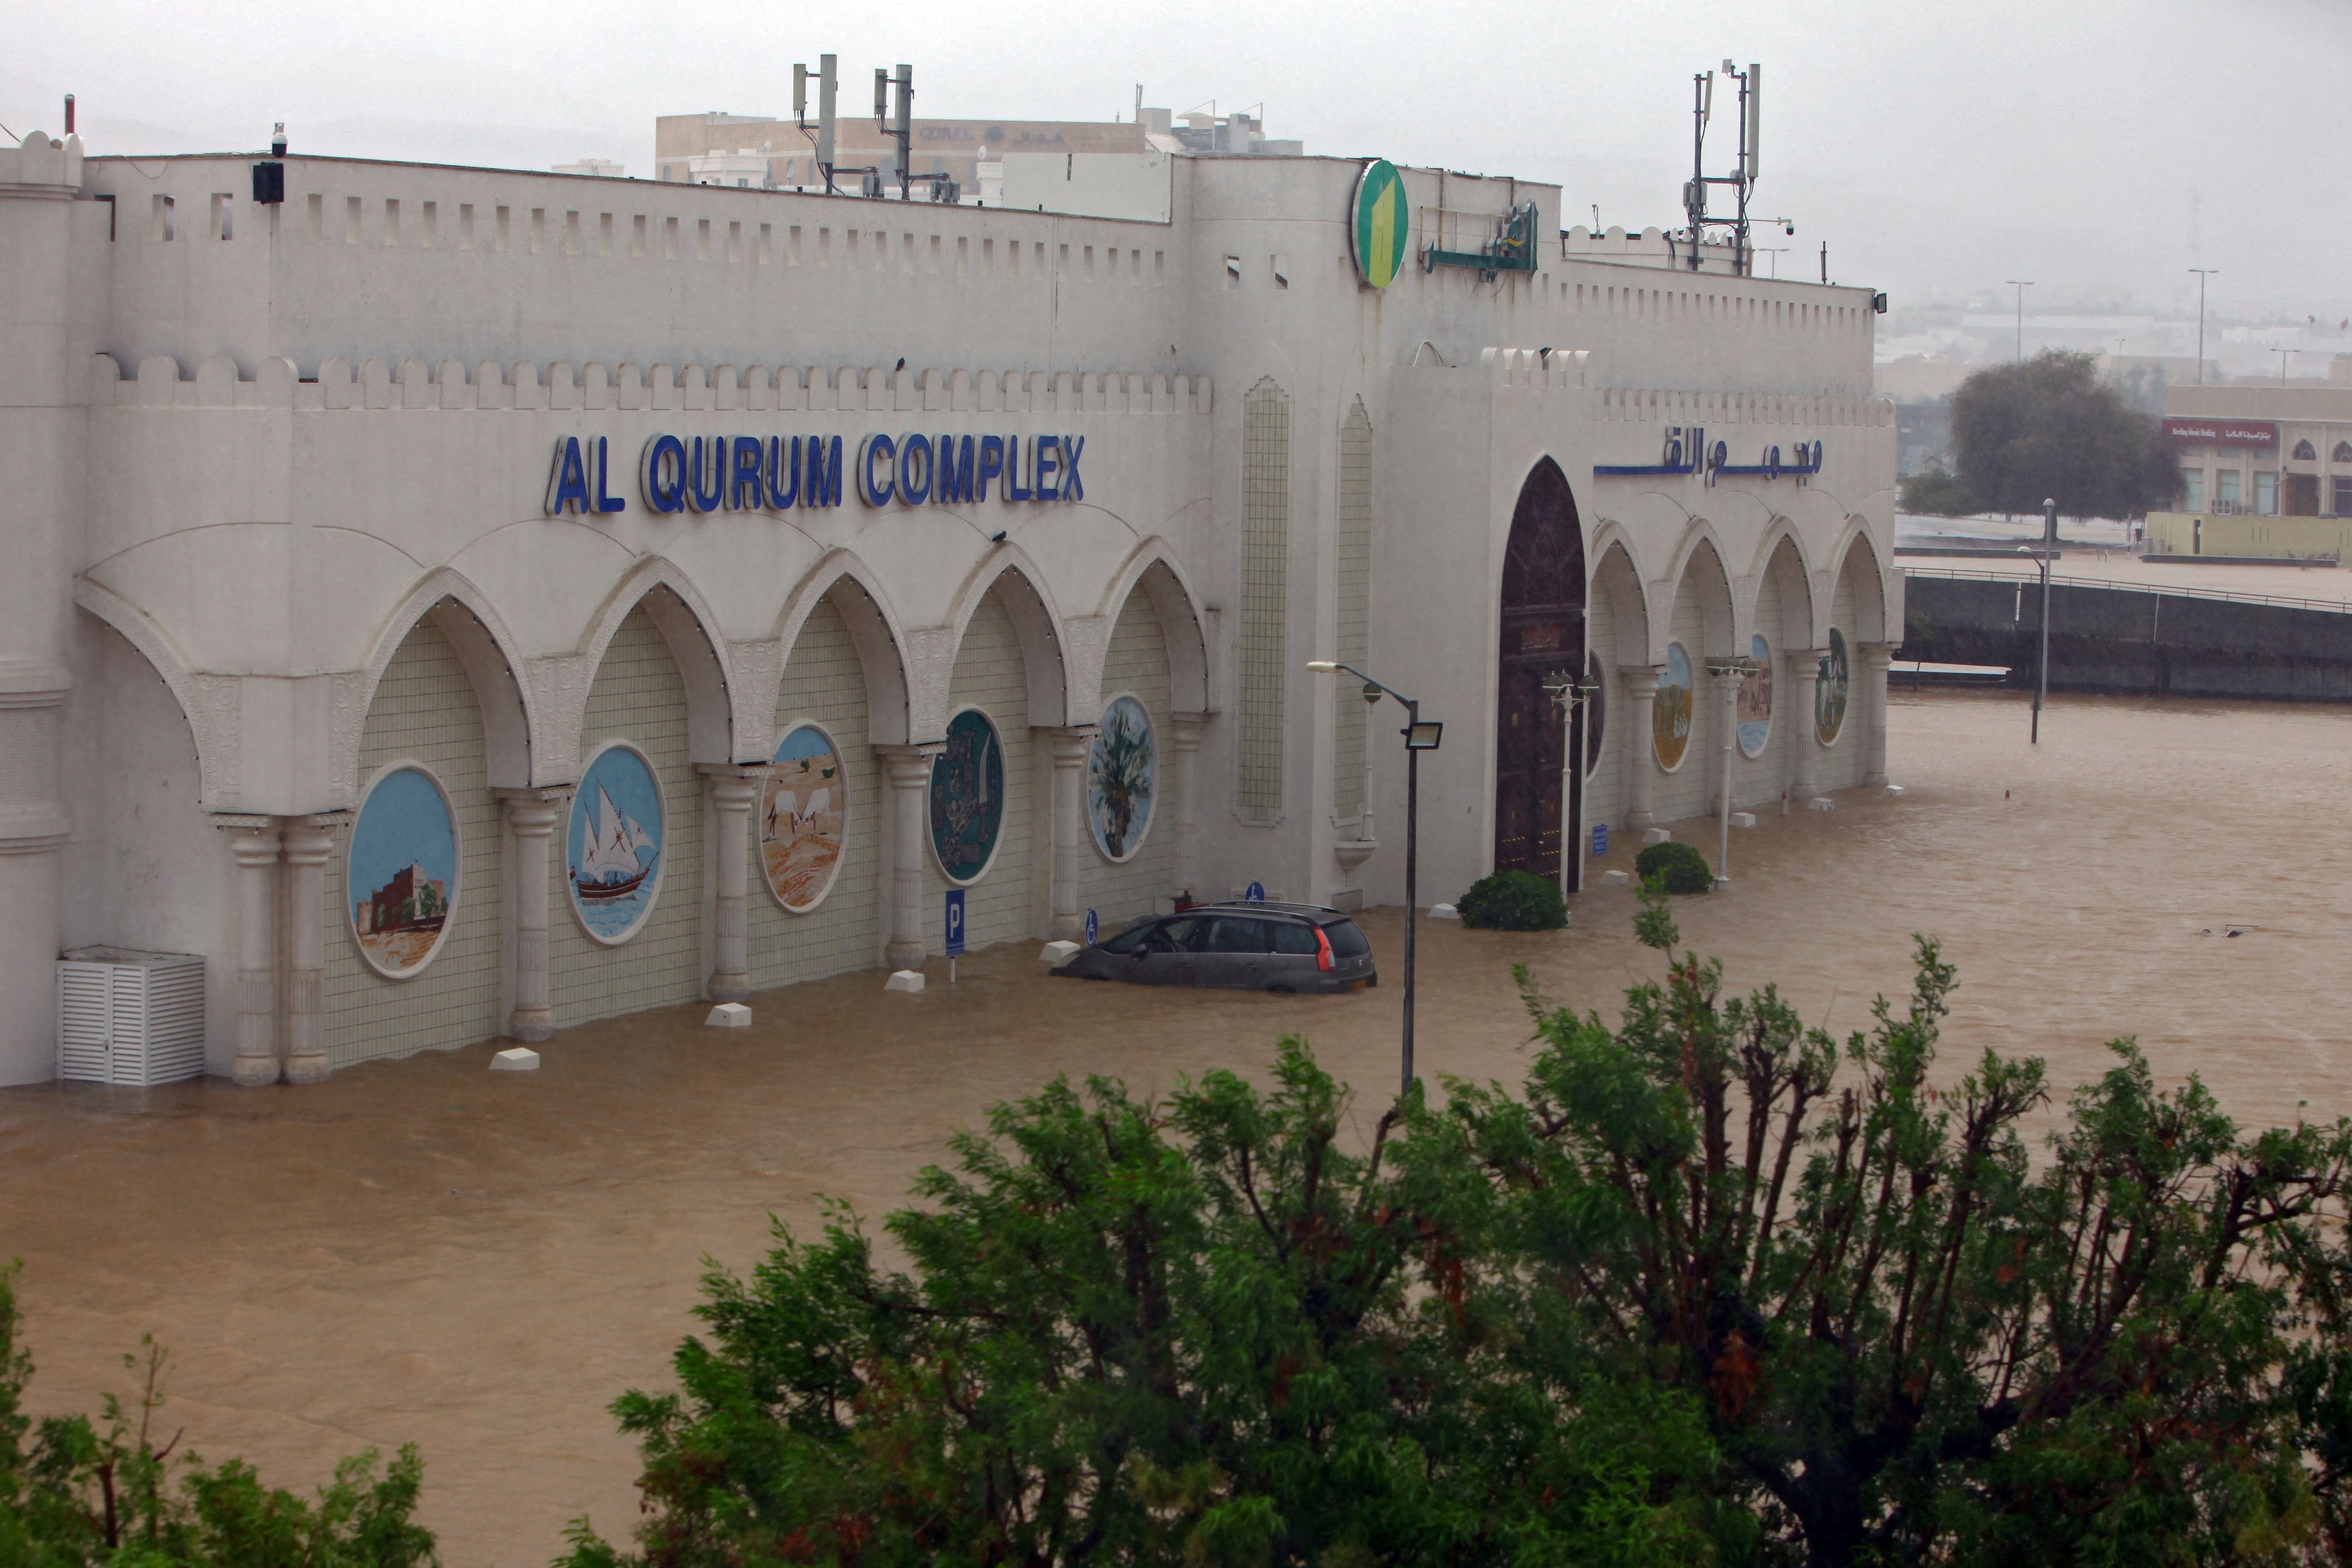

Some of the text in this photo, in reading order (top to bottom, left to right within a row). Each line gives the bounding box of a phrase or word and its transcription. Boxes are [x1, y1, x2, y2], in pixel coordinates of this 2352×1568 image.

[547, 433, 1085, 516] AL QURUM COMPLEX
[950, 903, 960, 938] P
